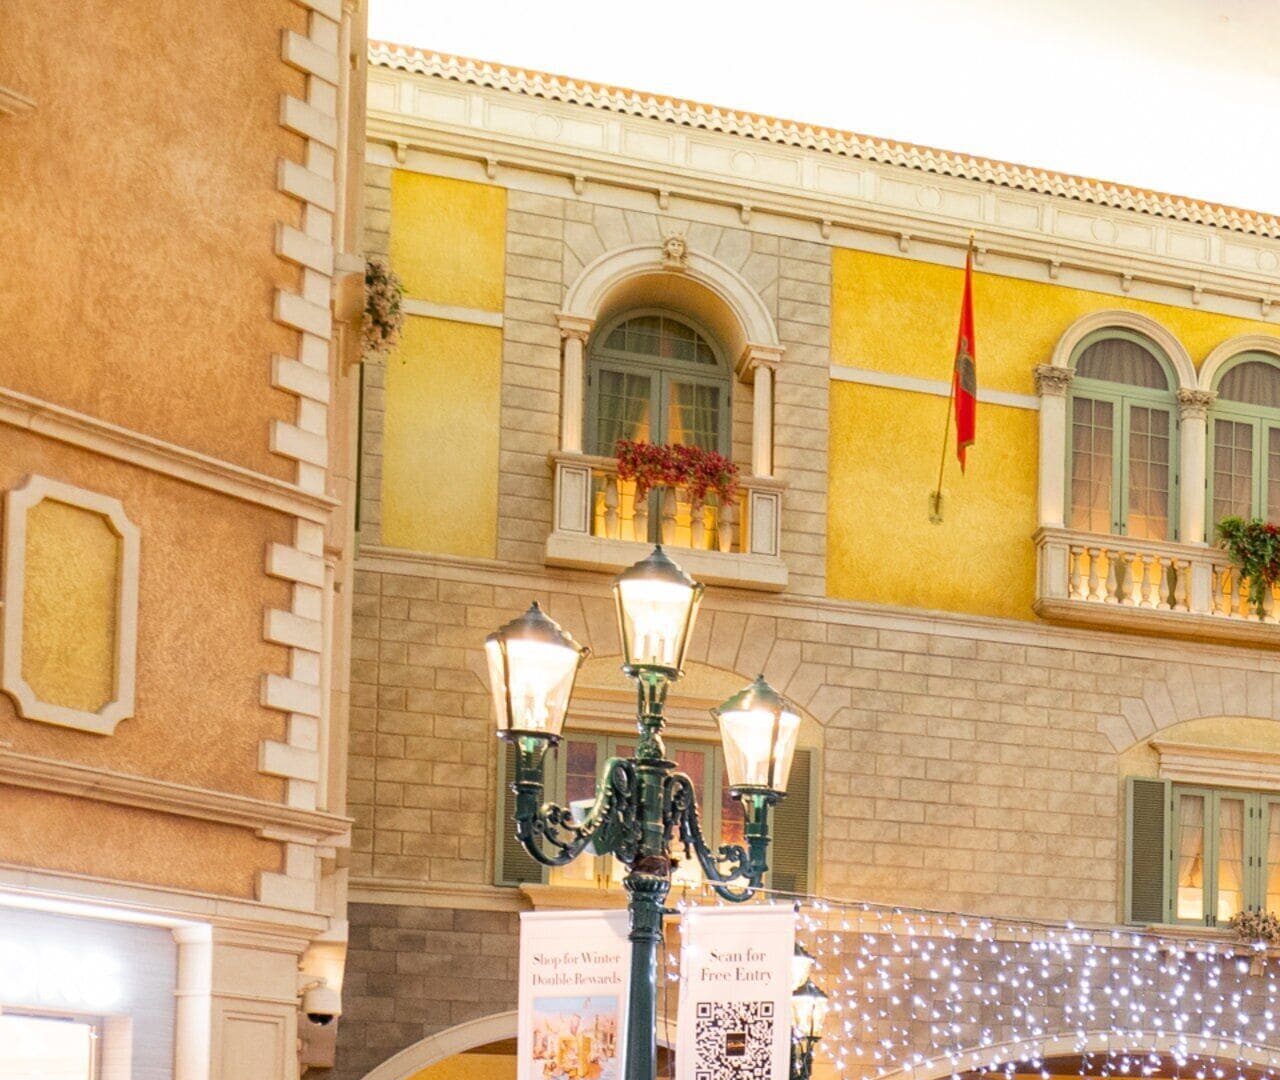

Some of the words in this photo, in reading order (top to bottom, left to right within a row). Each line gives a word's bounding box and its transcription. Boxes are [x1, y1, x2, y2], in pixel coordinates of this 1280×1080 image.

[532, 952, 561, 969] Shop
[563, 951, 578, 965] for
[581, 952, 621, 964] Winter
[710, 948, 742, 962] Scan
[747, 947, 766, 962] for
[532, 973, 572, 986] Double
[574, 971, 622, 985] Rewards
[700, 968, 731, 982] Free
[735, 967, 773, 986] Entry
